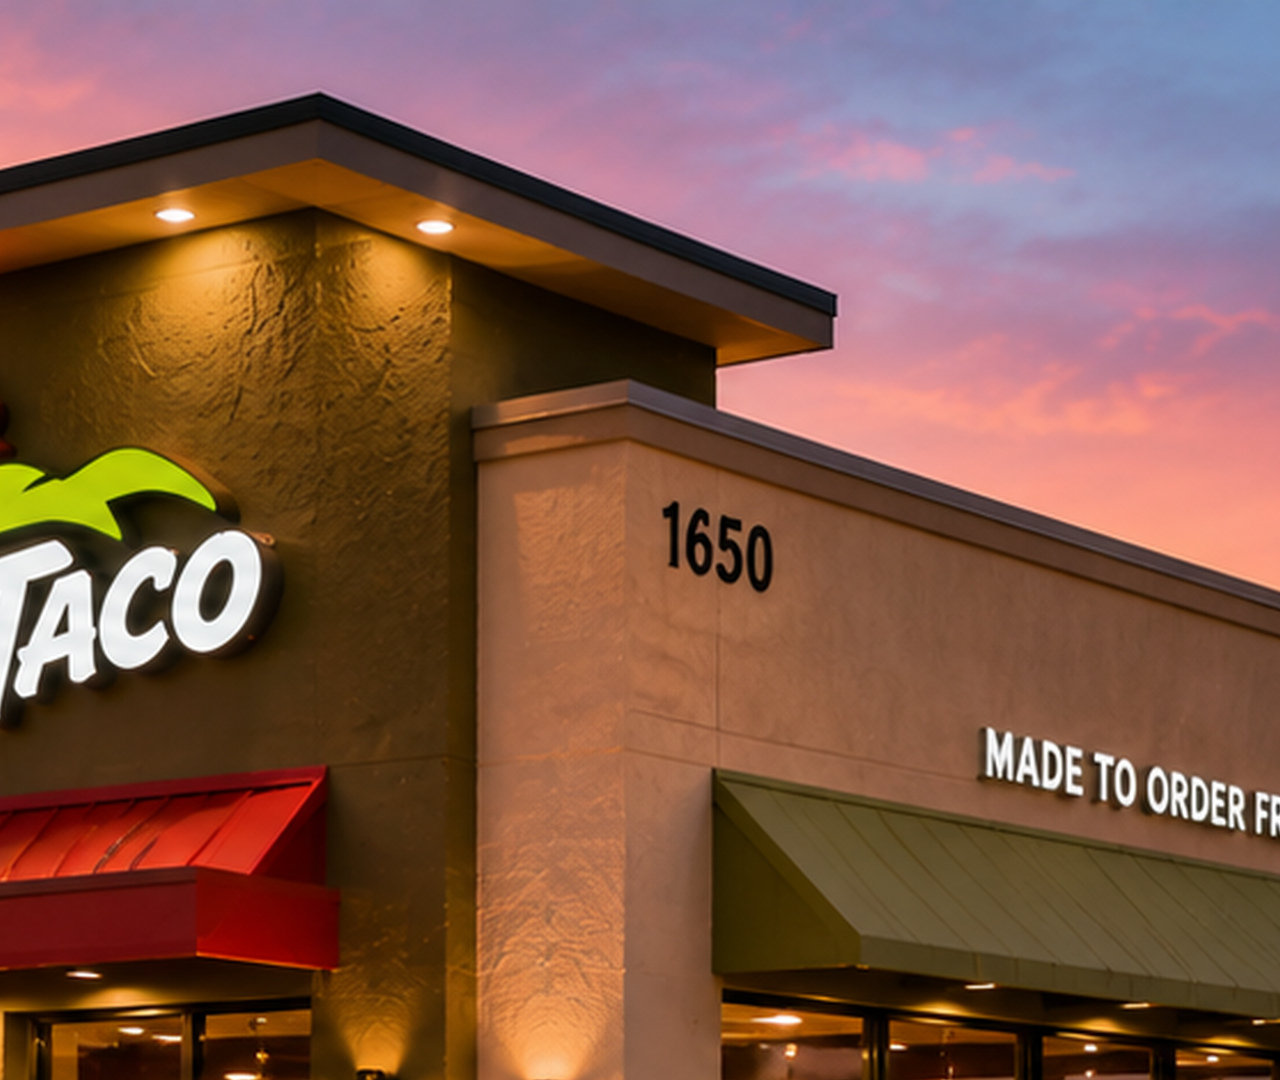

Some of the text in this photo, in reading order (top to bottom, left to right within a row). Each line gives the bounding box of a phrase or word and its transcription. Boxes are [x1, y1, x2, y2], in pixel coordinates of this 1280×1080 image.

[662, 500, 773, 593] 1650
[985, 726, 1084, 797] MADE
[1094, 752, 1137, 808] TO
[1146, 766, 1246, 832] ORDER
